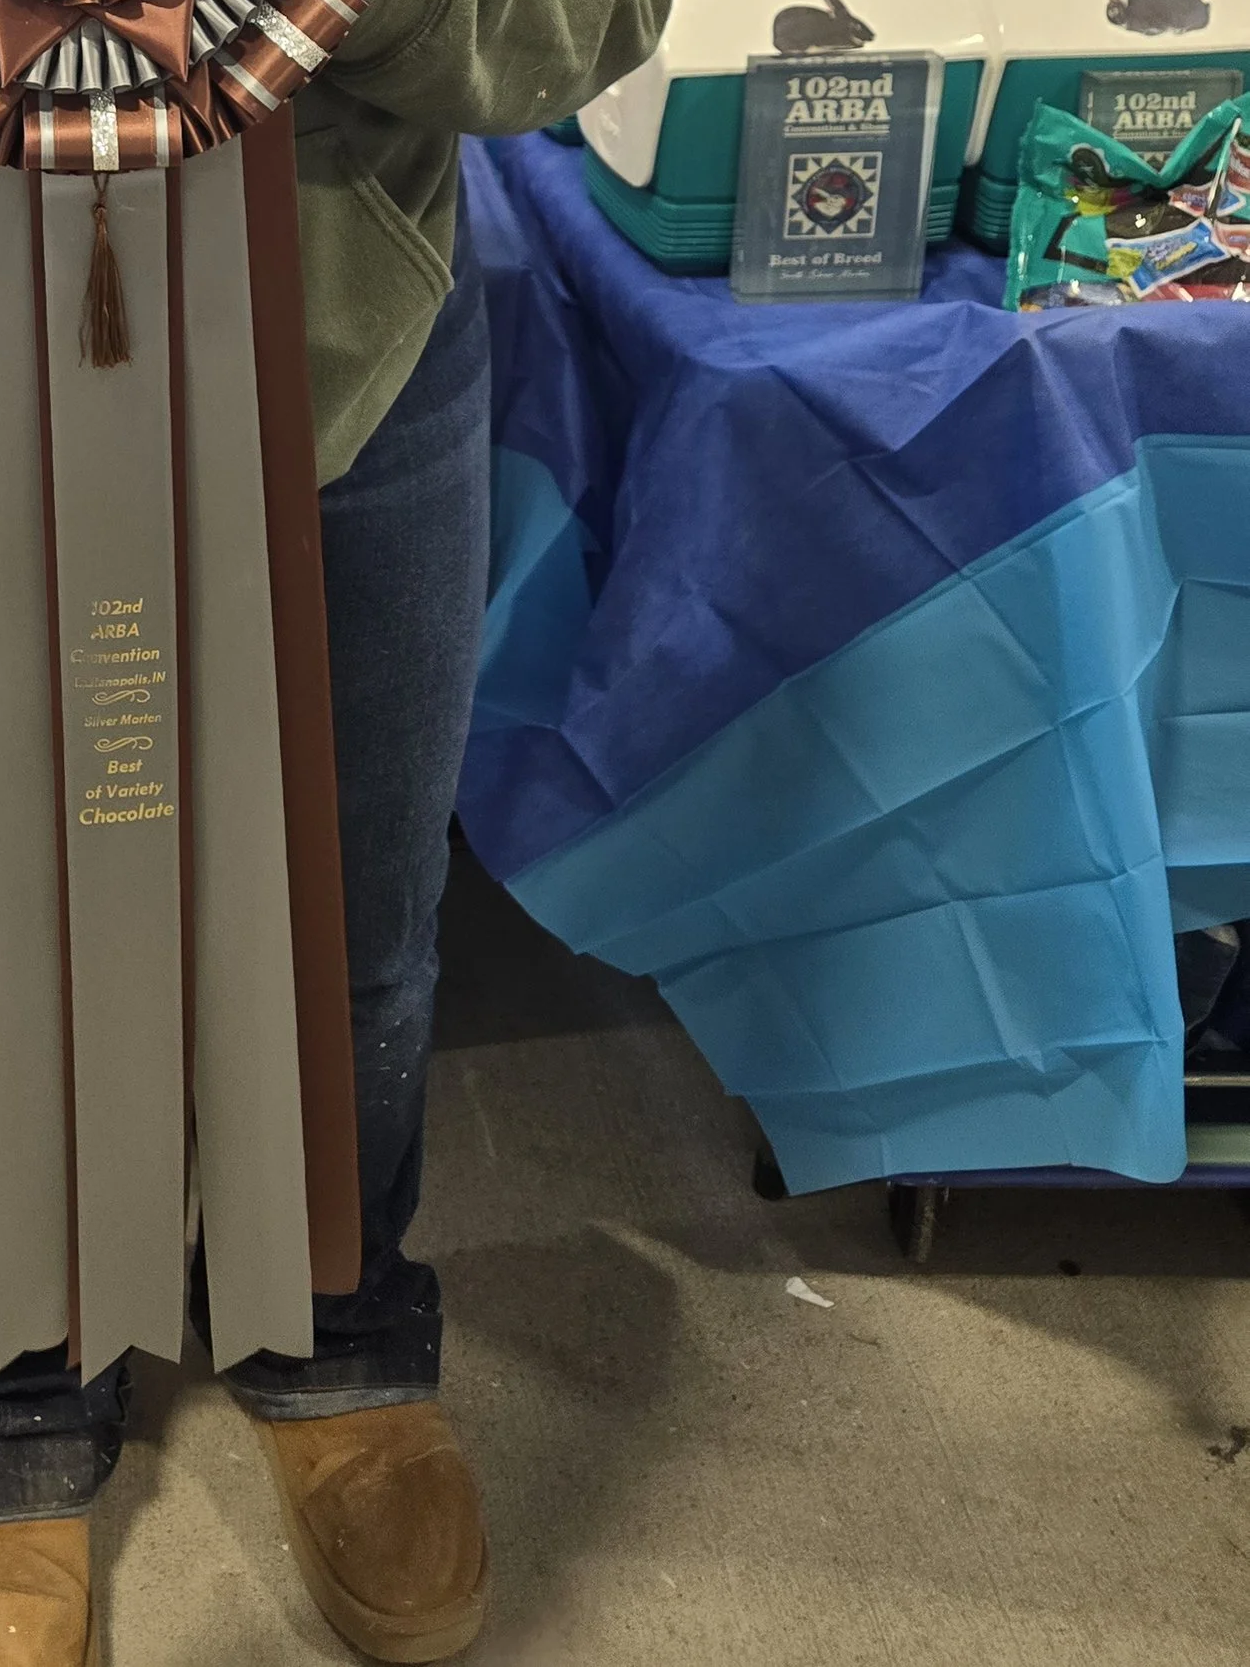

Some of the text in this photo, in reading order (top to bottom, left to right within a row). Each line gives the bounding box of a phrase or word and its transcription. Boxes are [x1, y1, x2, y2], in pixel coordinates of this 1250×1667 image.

[785, 72, 894, 101] 102nd
[1113, 90, 1196, 111] 102nd
[784, 97, 891, 124] ARBA
[1112, 110, 1193, 131] ARBA
[768, 251, 883, 268] Best of Breed
[91, 597, 144, 616] 102nd
[90, 622, 140, 639] ARBA
[70, 647, 160, 664] Cnvention
[120, 714, 162, 725] Marten
[107, 759, 144, 774] Best
[85, 781, 164, 799] of Variety
[78, 802, 175, 825] Chocolate
